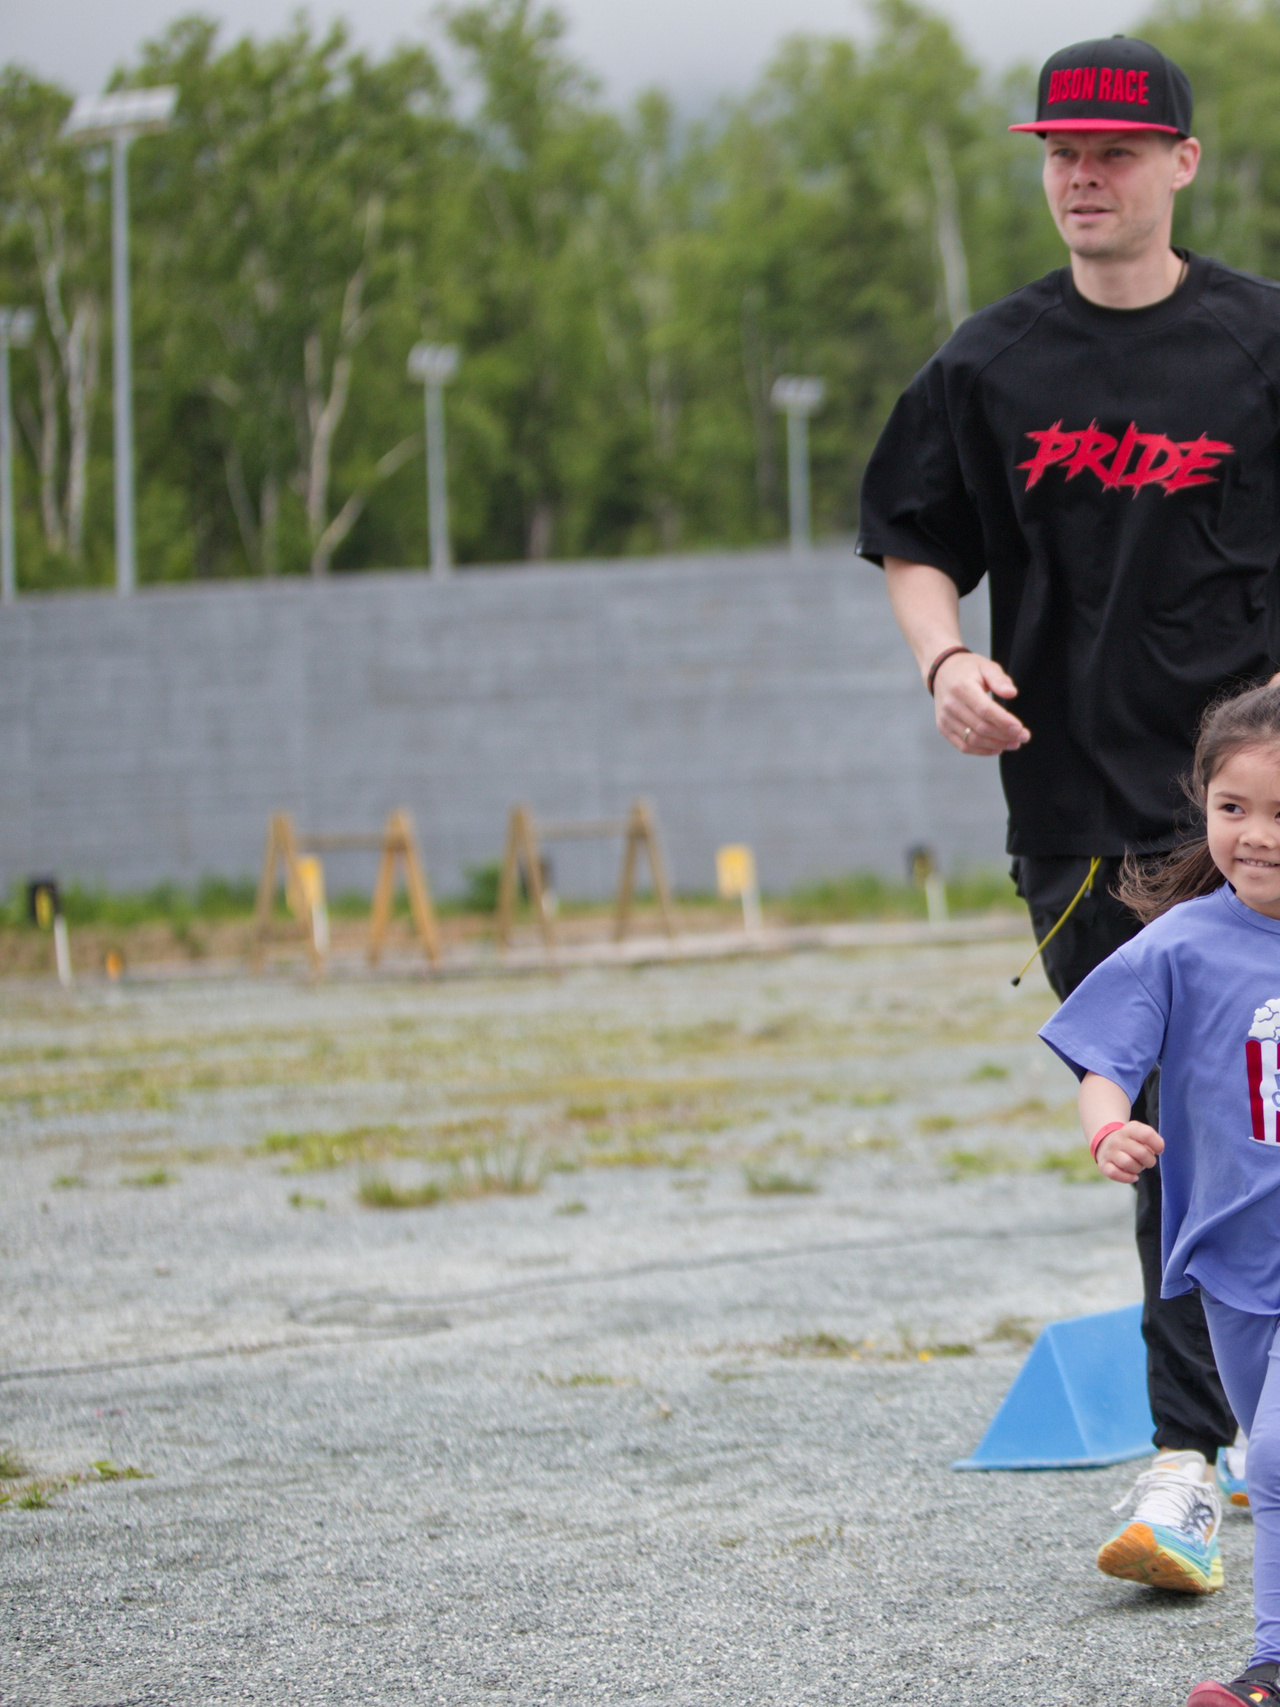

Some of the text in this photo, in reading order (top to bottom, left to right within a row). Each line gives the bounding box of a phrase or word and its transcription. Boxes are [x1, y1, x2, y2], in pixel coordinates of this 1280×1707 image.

[1048, 66, 1149, 106] BISON RACE
[1014, 417, 1236, 500] PRIDE
